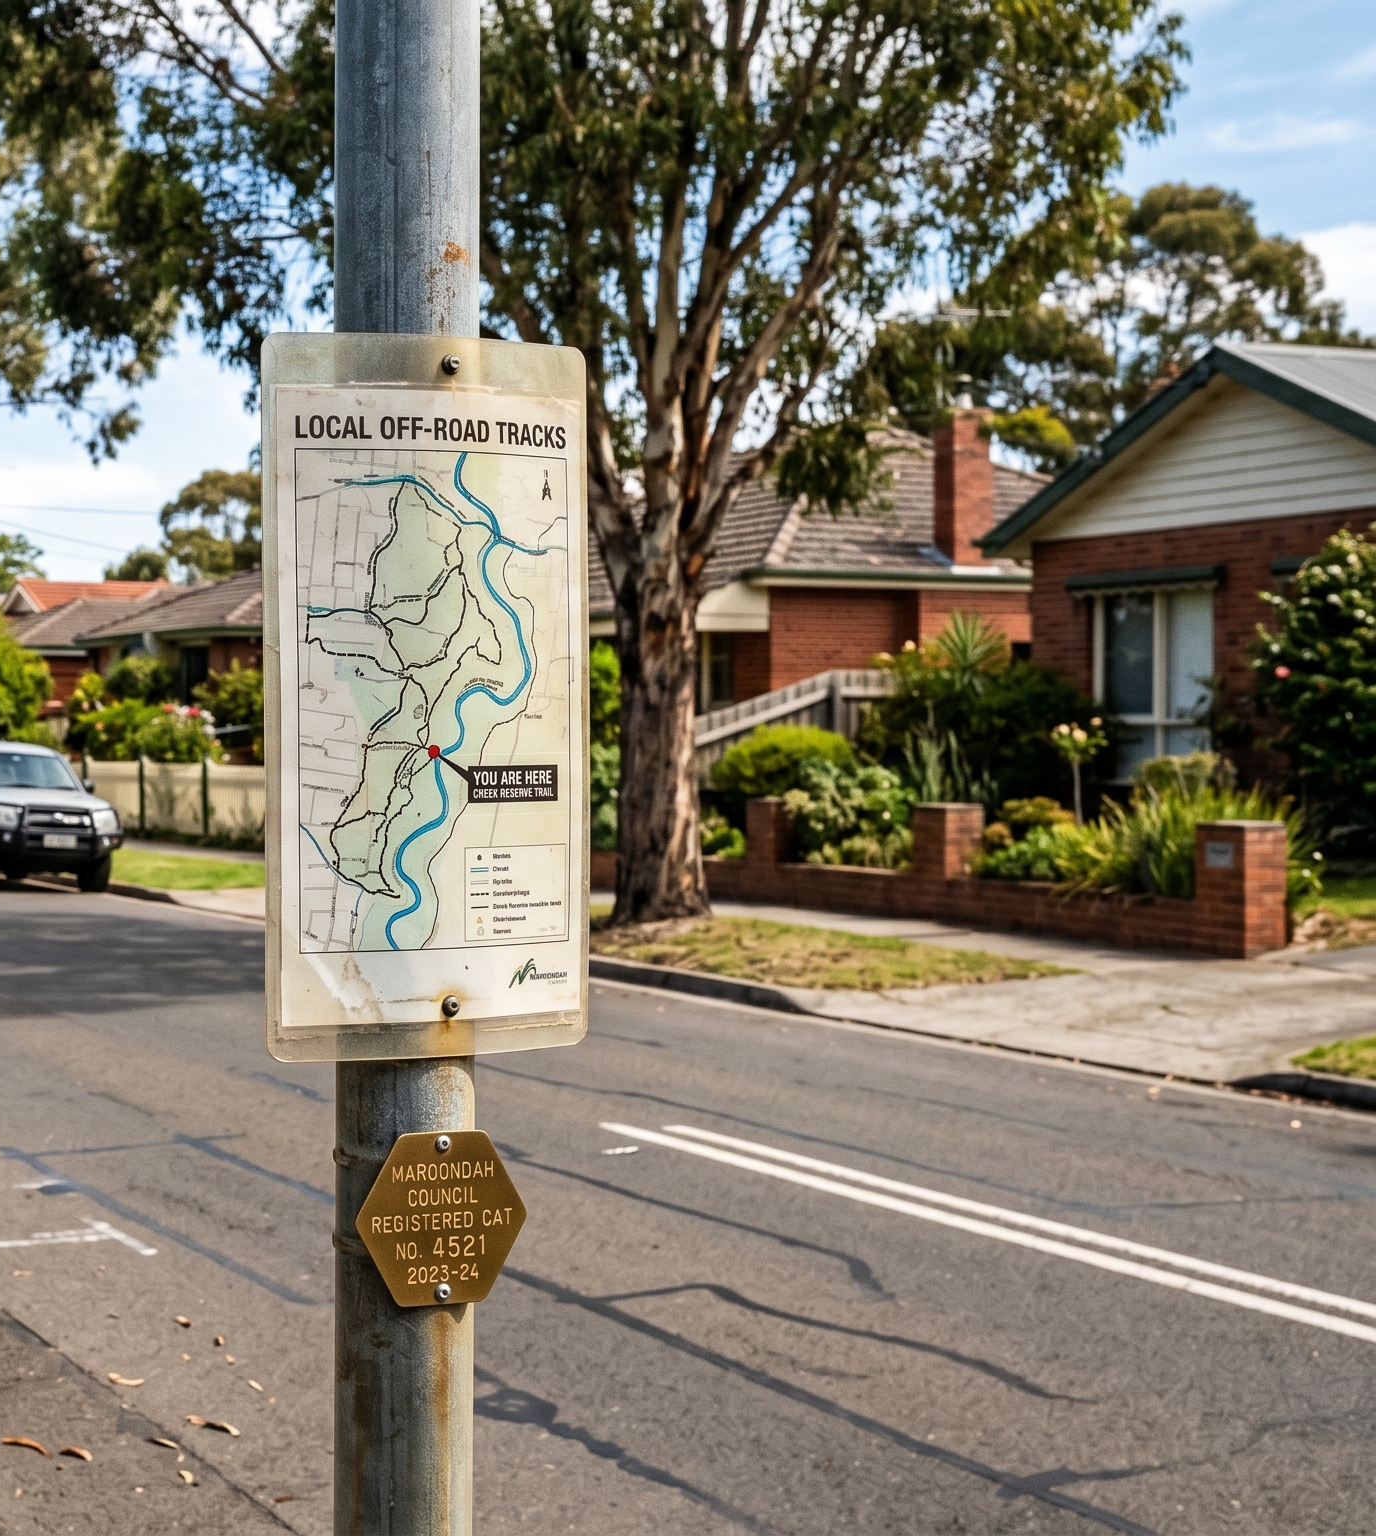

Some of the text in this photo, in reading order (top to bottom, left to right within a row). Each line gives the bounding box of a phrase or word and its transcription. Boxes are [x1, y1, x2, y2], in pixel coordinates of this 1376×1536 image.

[295, 415, 566, 449] LOCAL OFF-ROAD TRACKS
[473, 770, 552, 785] YOU ARE HERE
[473, 787, 553, 798] CREEK RESERVE TRAIL
[392, 1160, 494, 1183] MAROONDAH
[408, 1186, 478, 1207] COUNCIL
[371, 1208, 513, 1234] REGISTERED CAT
[396, 1234, 485, 1260] NO. 4521
[407, 1263, 479, 1285] 2023-24
